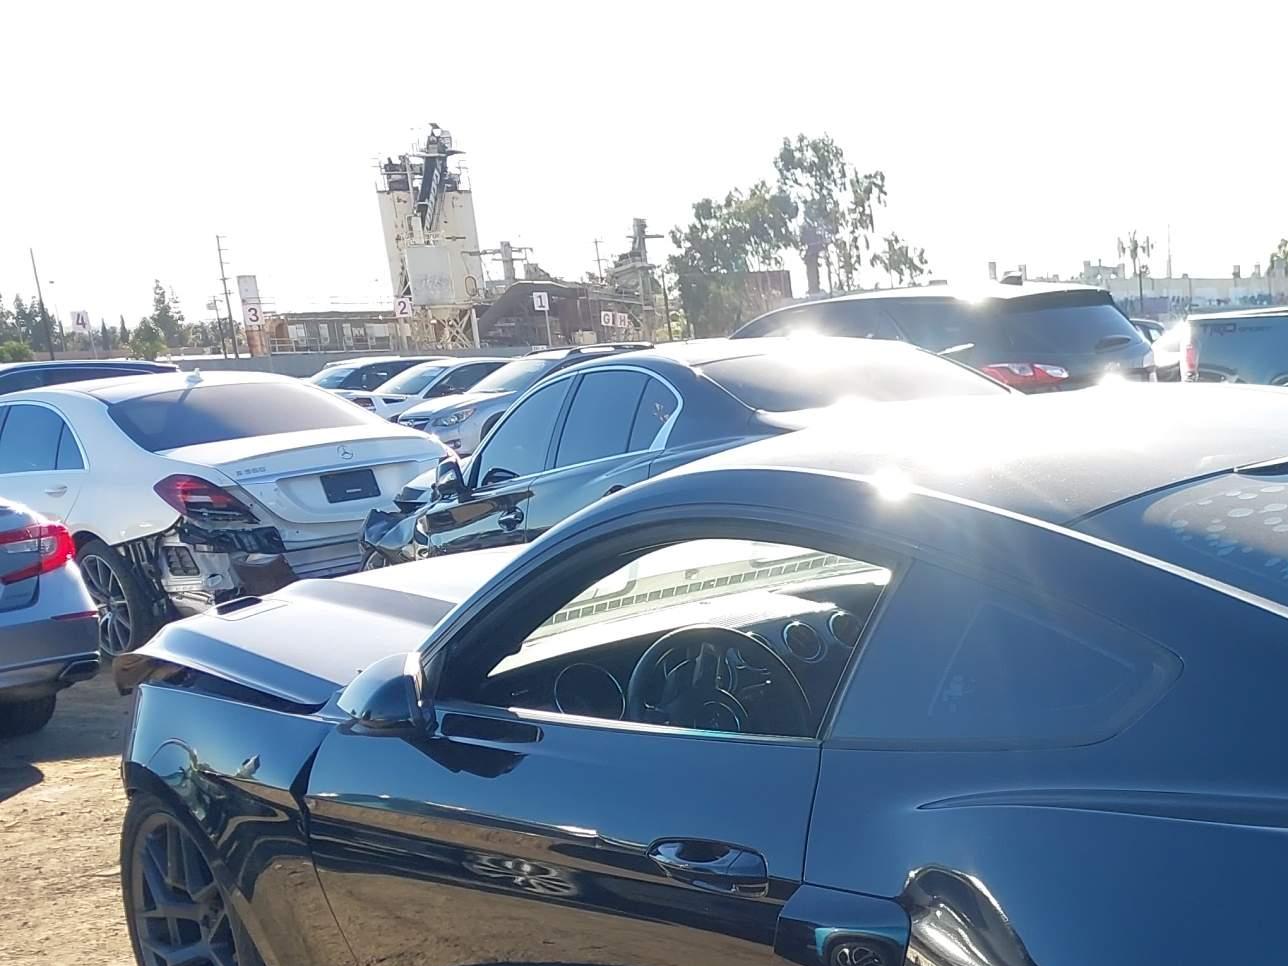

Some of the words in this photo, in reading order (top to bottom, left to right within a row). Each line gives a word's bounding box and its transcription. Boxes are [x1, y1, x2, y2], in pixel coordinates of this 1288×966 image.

[398, 301, 409, 315] 2
[537, 295, 546, 308] 1
[76, 313, 87, 328] 4
[247, 307, 259, 322] 3
